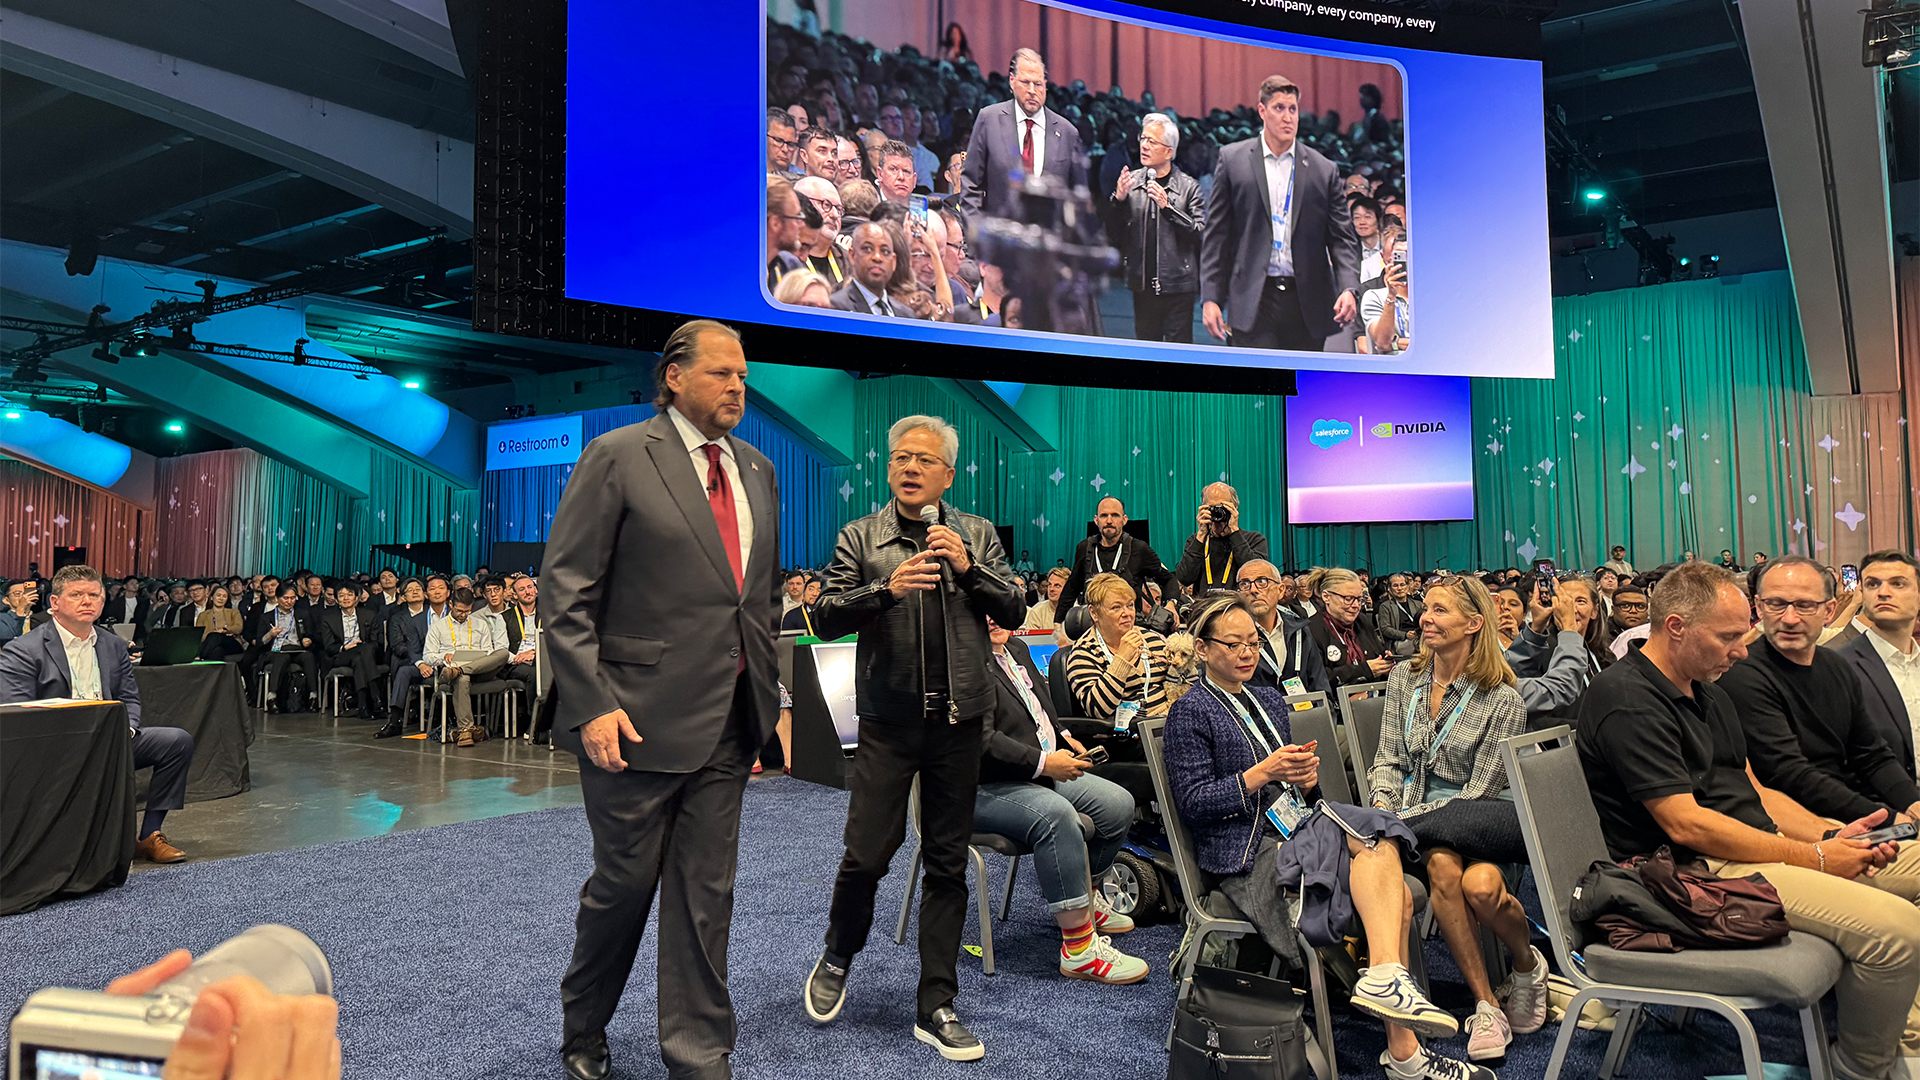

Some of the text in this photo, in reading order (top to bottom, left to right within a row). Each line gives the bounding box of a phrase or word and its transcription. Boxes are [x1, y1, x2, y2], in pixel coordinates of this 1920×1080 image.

[1259, 0, 1315, 16] company,
[1317, 5, 1347, 21] every
[1348, 10, 1404, 28] company,
[1405, 17, 1436, 33] every
[1315, 428, 1349, 438] salesforce
[1394, 421, 1447, 435] NVIDIA
[508, 438, 558, 453] Restroom
